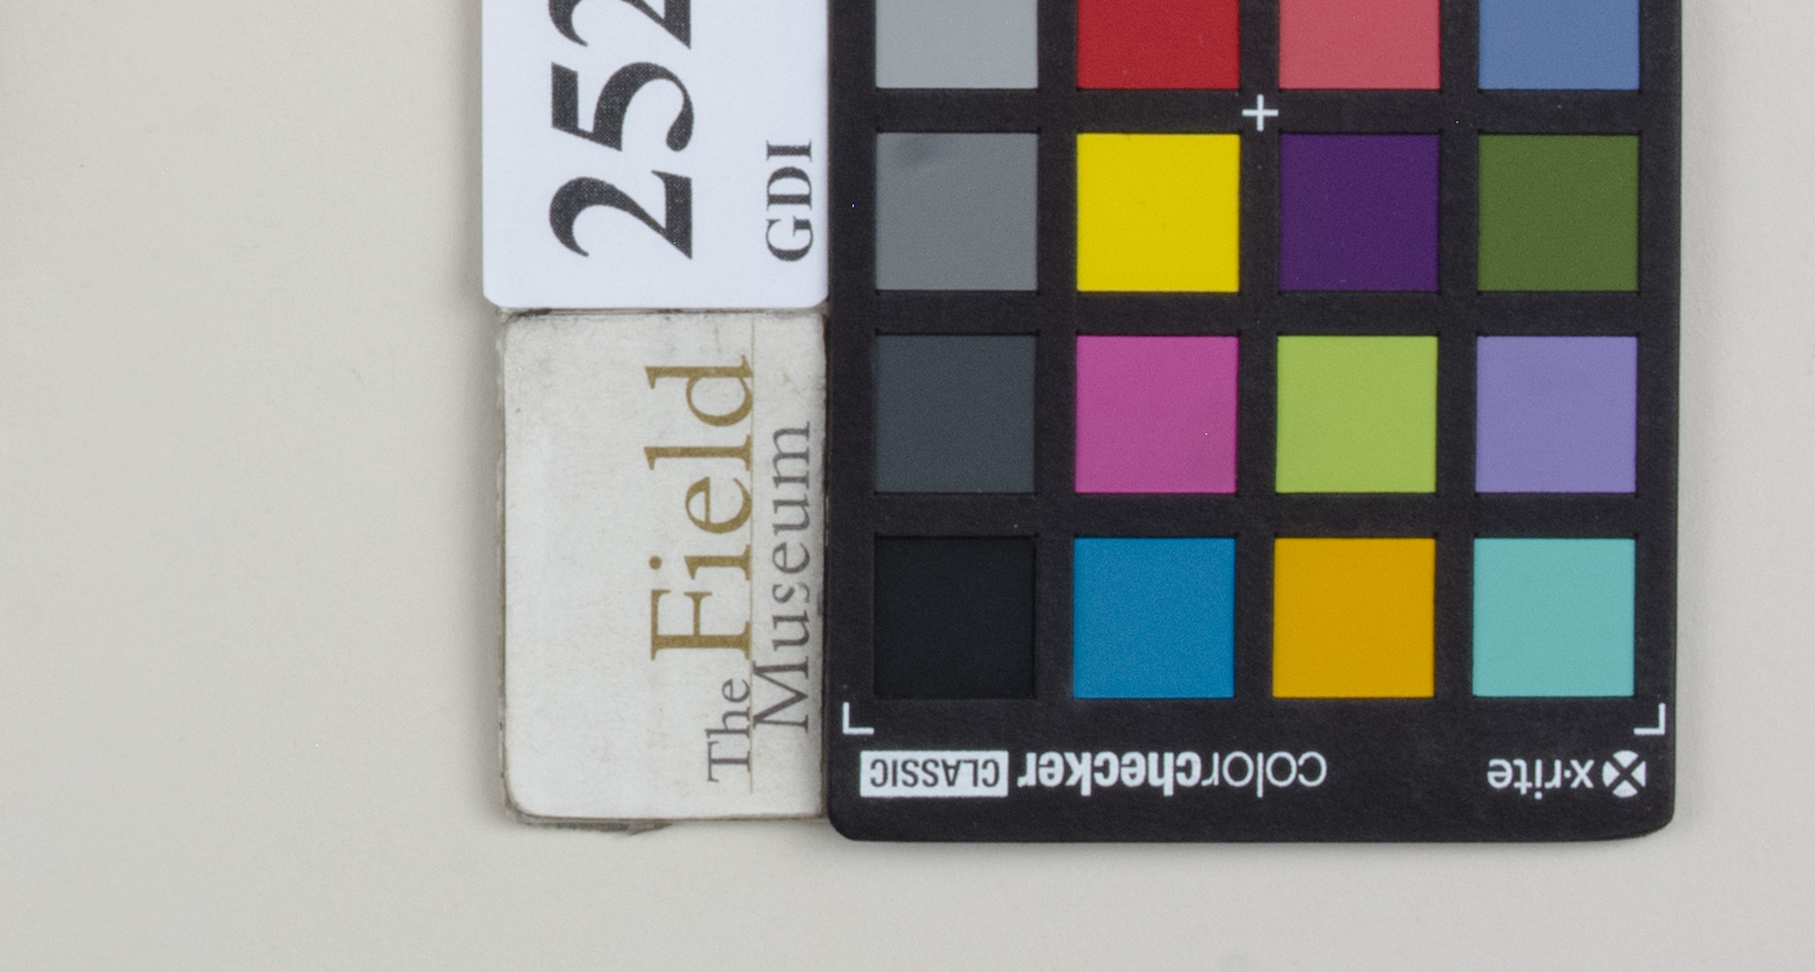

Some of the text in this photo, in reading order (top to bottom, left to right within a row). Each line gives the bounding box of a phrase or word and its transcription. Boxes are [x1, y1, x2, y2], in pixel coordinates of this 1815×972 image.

[766, 143, 814, 262] GDI
[644, 355, 754, 783] The Field
[752, 421, 811, 734] Museum
[867, 751, 1328, 798] colorchecker CLASSIC
